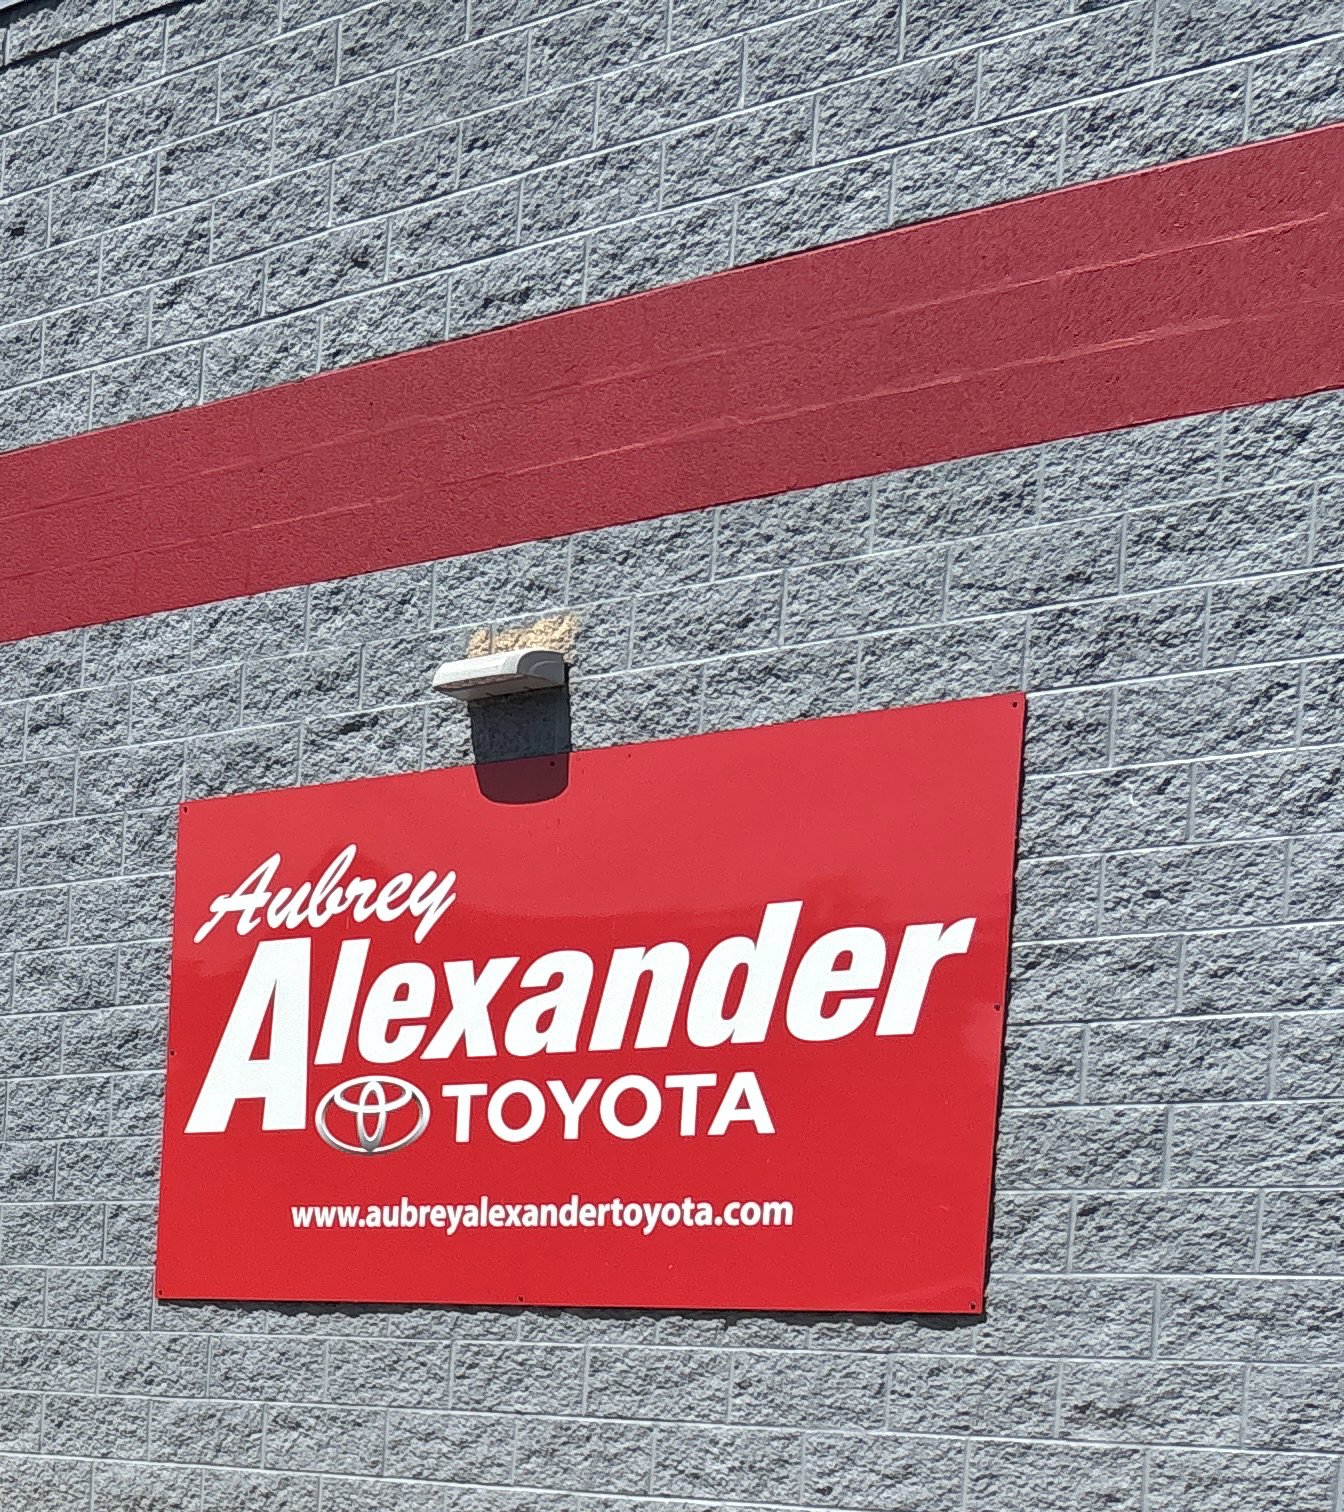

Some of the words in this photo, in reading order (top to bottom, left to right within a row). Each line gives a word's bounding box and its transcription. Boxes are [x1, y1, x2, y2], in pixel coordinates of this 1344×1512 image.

[193, 843, 457, 945] Aubrey
[183, 900, 977, 1134] Alexander
[441, 1071, 776, 1143] TOYOTA
[290, 1194, 795, 1236] www.aubreyalexandertoyota.com
